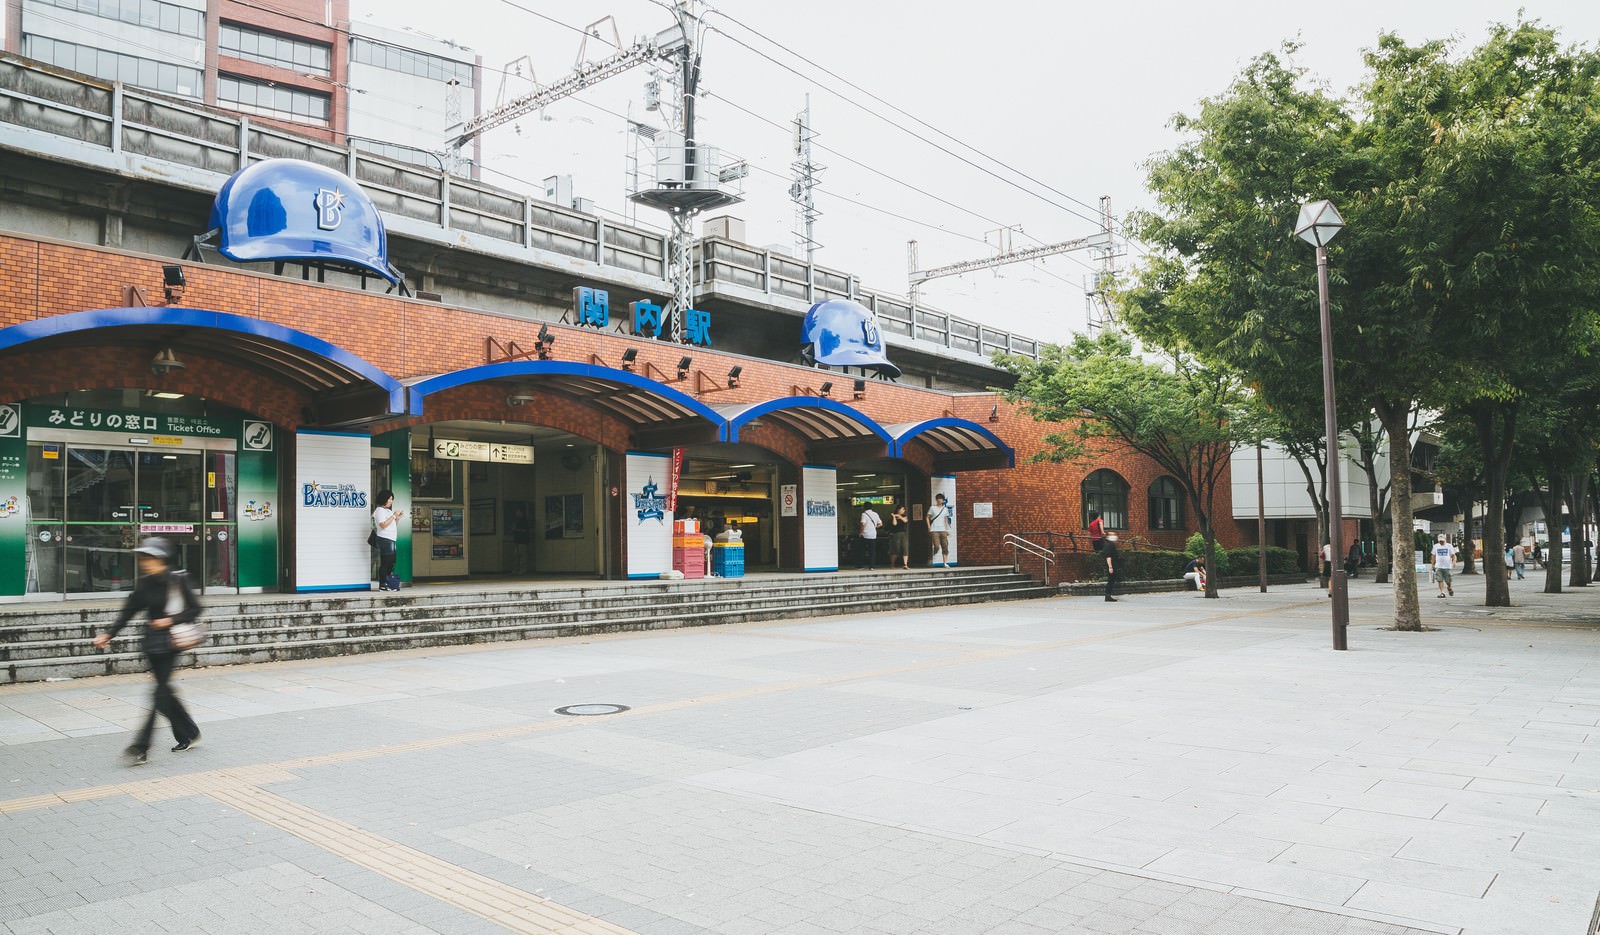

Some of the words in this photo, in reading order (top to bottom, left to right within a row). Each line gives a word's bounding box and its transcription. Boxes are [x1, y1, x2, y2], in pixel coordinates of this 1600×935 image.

[573, 286, 712, 346] 関内駅
[48, 409, 158, 431] みどりの窓口
[167, 423, 194, 433] Ticket
[196, 425, 221, 434] Office
[302, 483, 368, 508] BAYSTARS
